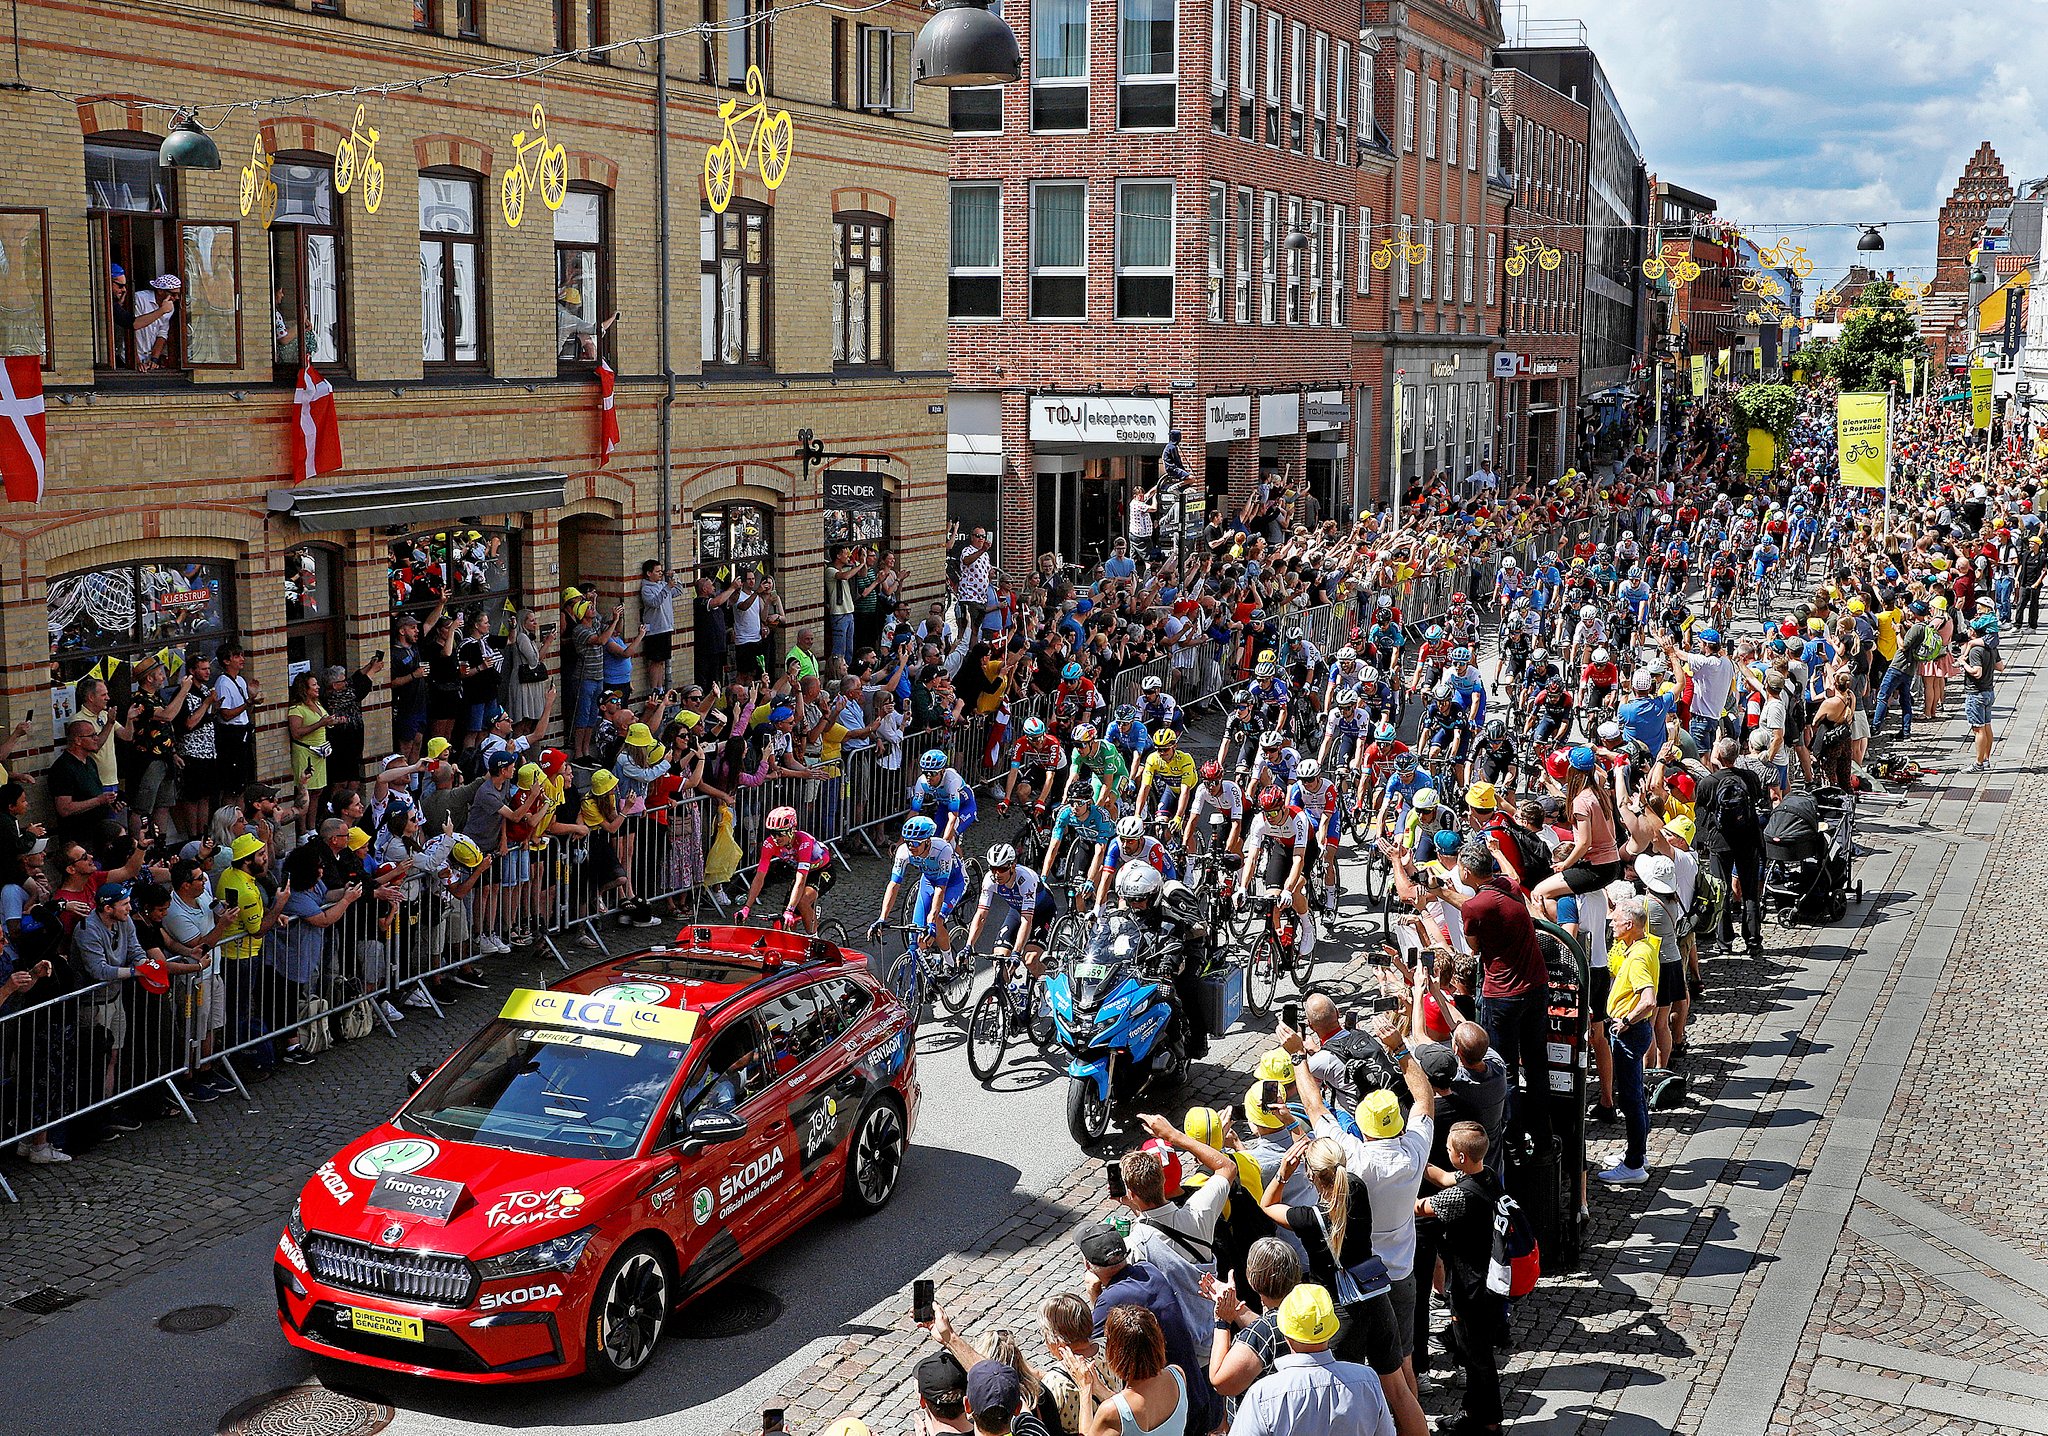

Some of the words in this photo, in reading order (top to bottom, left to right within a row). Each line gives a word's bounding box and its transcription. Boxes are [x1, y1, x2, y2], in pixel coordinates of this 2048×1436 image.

[2008, 296, 2017, 349] PRINDSEN
[1432, 362, 1455, 377] Nordea
[1842, 418, 1882, 426] Bienvenue
[1849, 424, 1882, 432] Roskilde
[1116, 430, 1156, 442] Egebjerg
[831, 484, 875, 497] STENDER
[164, 590, 207, 604] KJÆRSTRUP
[535, 998, 557, 1008] LCL
[562, 999, 622, 1027] LCL
[635, 1010, 660, 1023] LCL
[537, 1032, 570, 1042] OFFICIEL
[621, 1043, 626, 1051] 1
[719, 1145, 784, 1204] ŠKODA
[316, 1161, 354, 1206] ŠKODA
[406, 1195, 445, 1210] sport
[719, 1197, 745, 1220] Official
[744, 1188, 760, 1204] Main
[760, 1170, 784, 1192] Partner
[479, 1283, 563, 1310] ŠKODA
[355, 1312, 402, 1326] DIRECTION
[408, 1323, 418, 1336] 1
